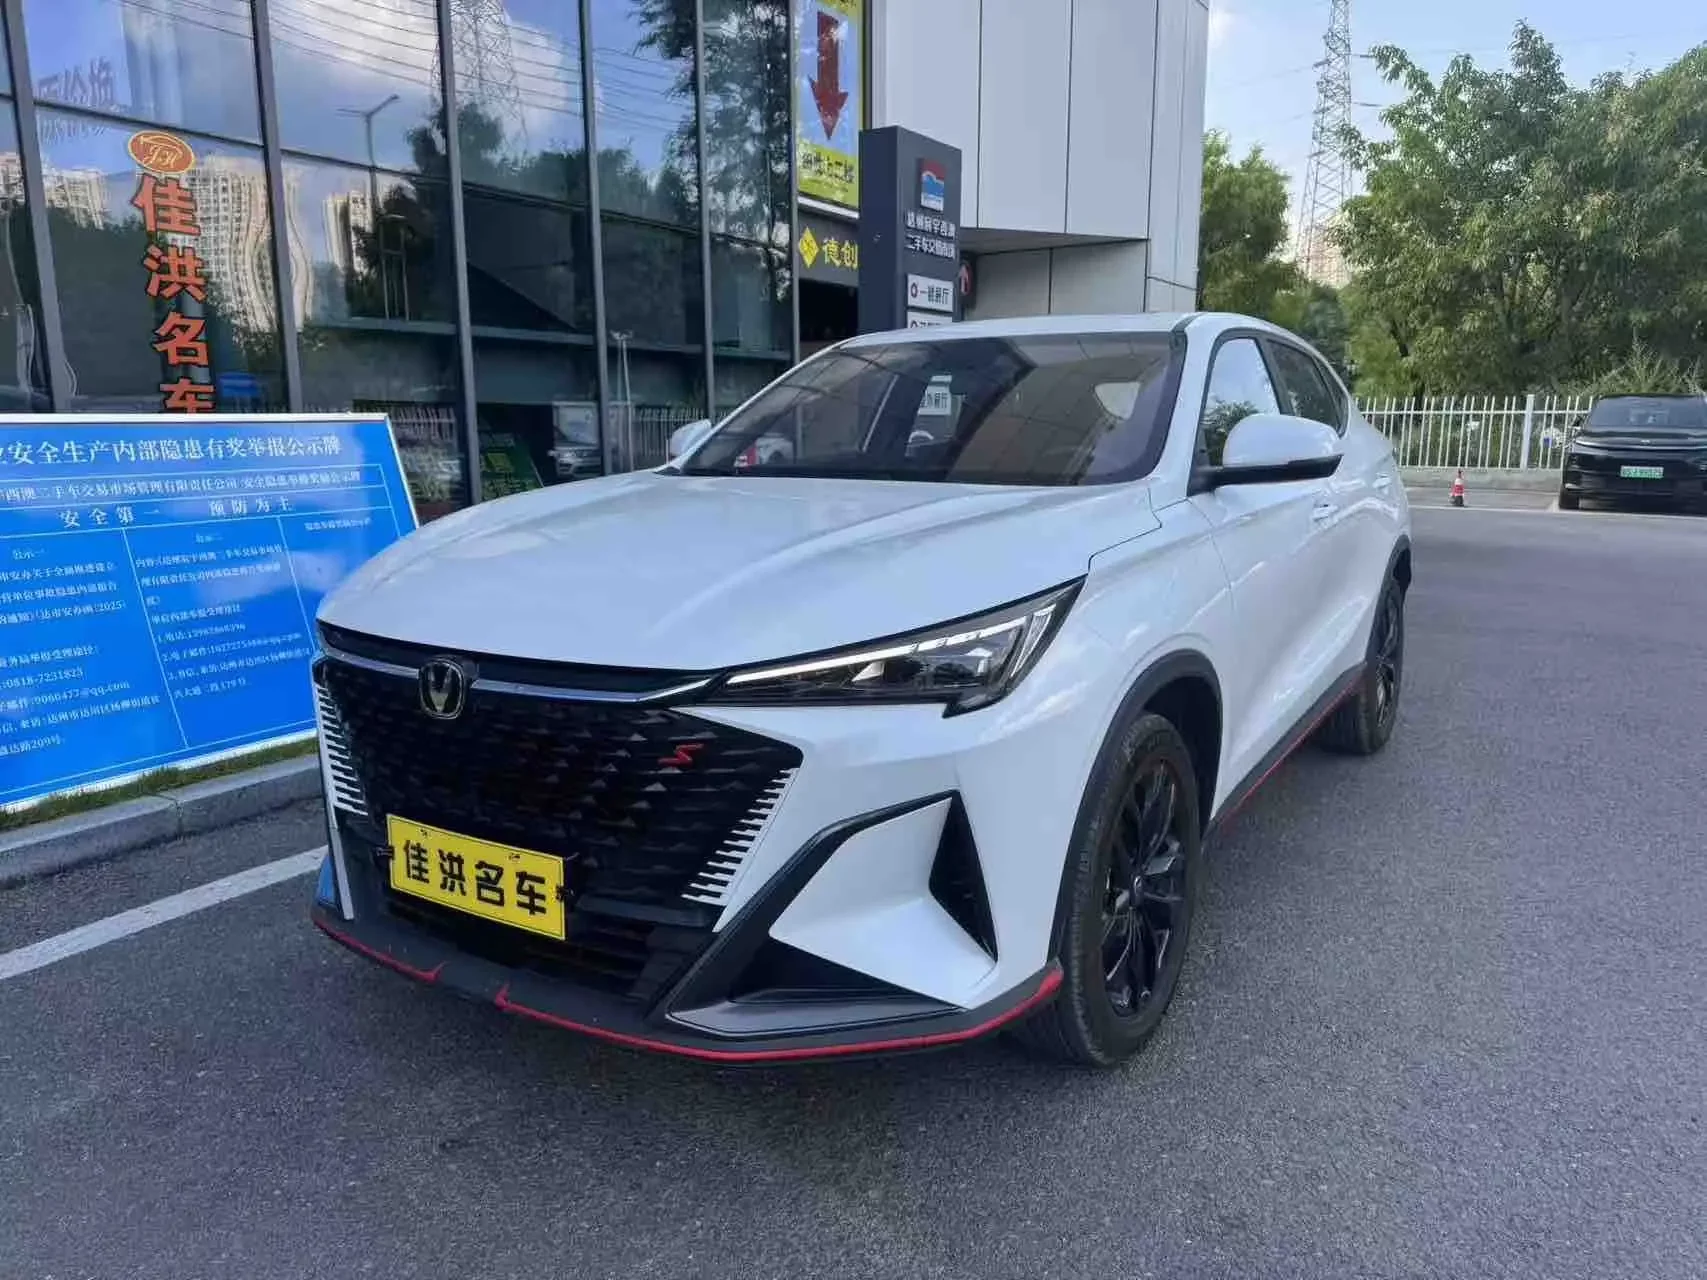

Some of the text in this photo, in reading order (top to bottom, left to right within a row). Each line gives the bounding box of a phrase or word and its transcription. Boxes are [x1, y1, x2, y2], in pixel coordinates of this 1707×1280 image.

[822, 237, 859, 270] 德创
[130, 173, 216, 413] 佳洪名车
[0, 434, 343, 465] 安全生产内部隐患有奖举报公示牌
[58, 496, 293, 529] 安全第一 预防为主
[403, 840, 547, 915] 佳洪名车
